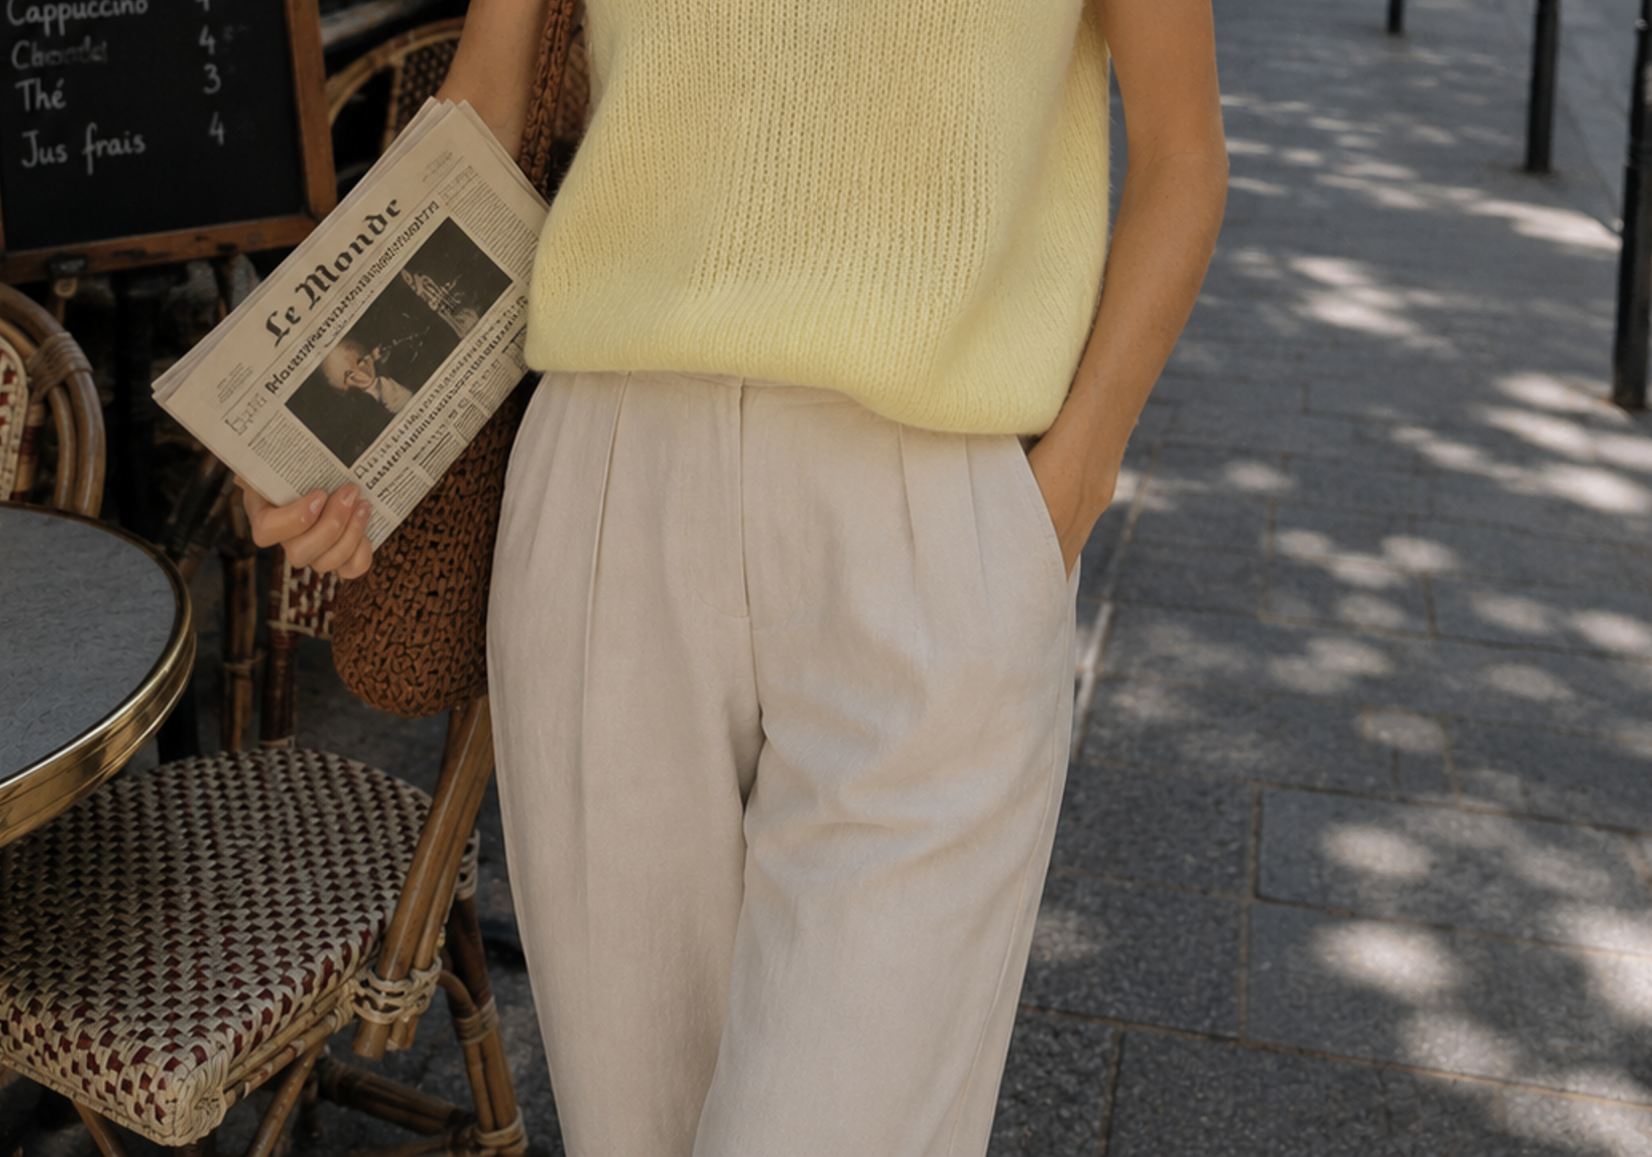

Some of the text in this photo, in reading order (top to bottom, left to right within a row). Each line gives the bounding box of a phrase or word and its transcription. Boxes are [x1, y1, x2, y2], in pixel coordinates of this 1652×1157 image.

[198, 23, 217, 56] 4
[14, 62, 222, 113] Thé 3
[21, 111, 226, 176] Jus frais 4
[264, 304, 301, 348] Le
[294, 198, 402, 310] Monde
